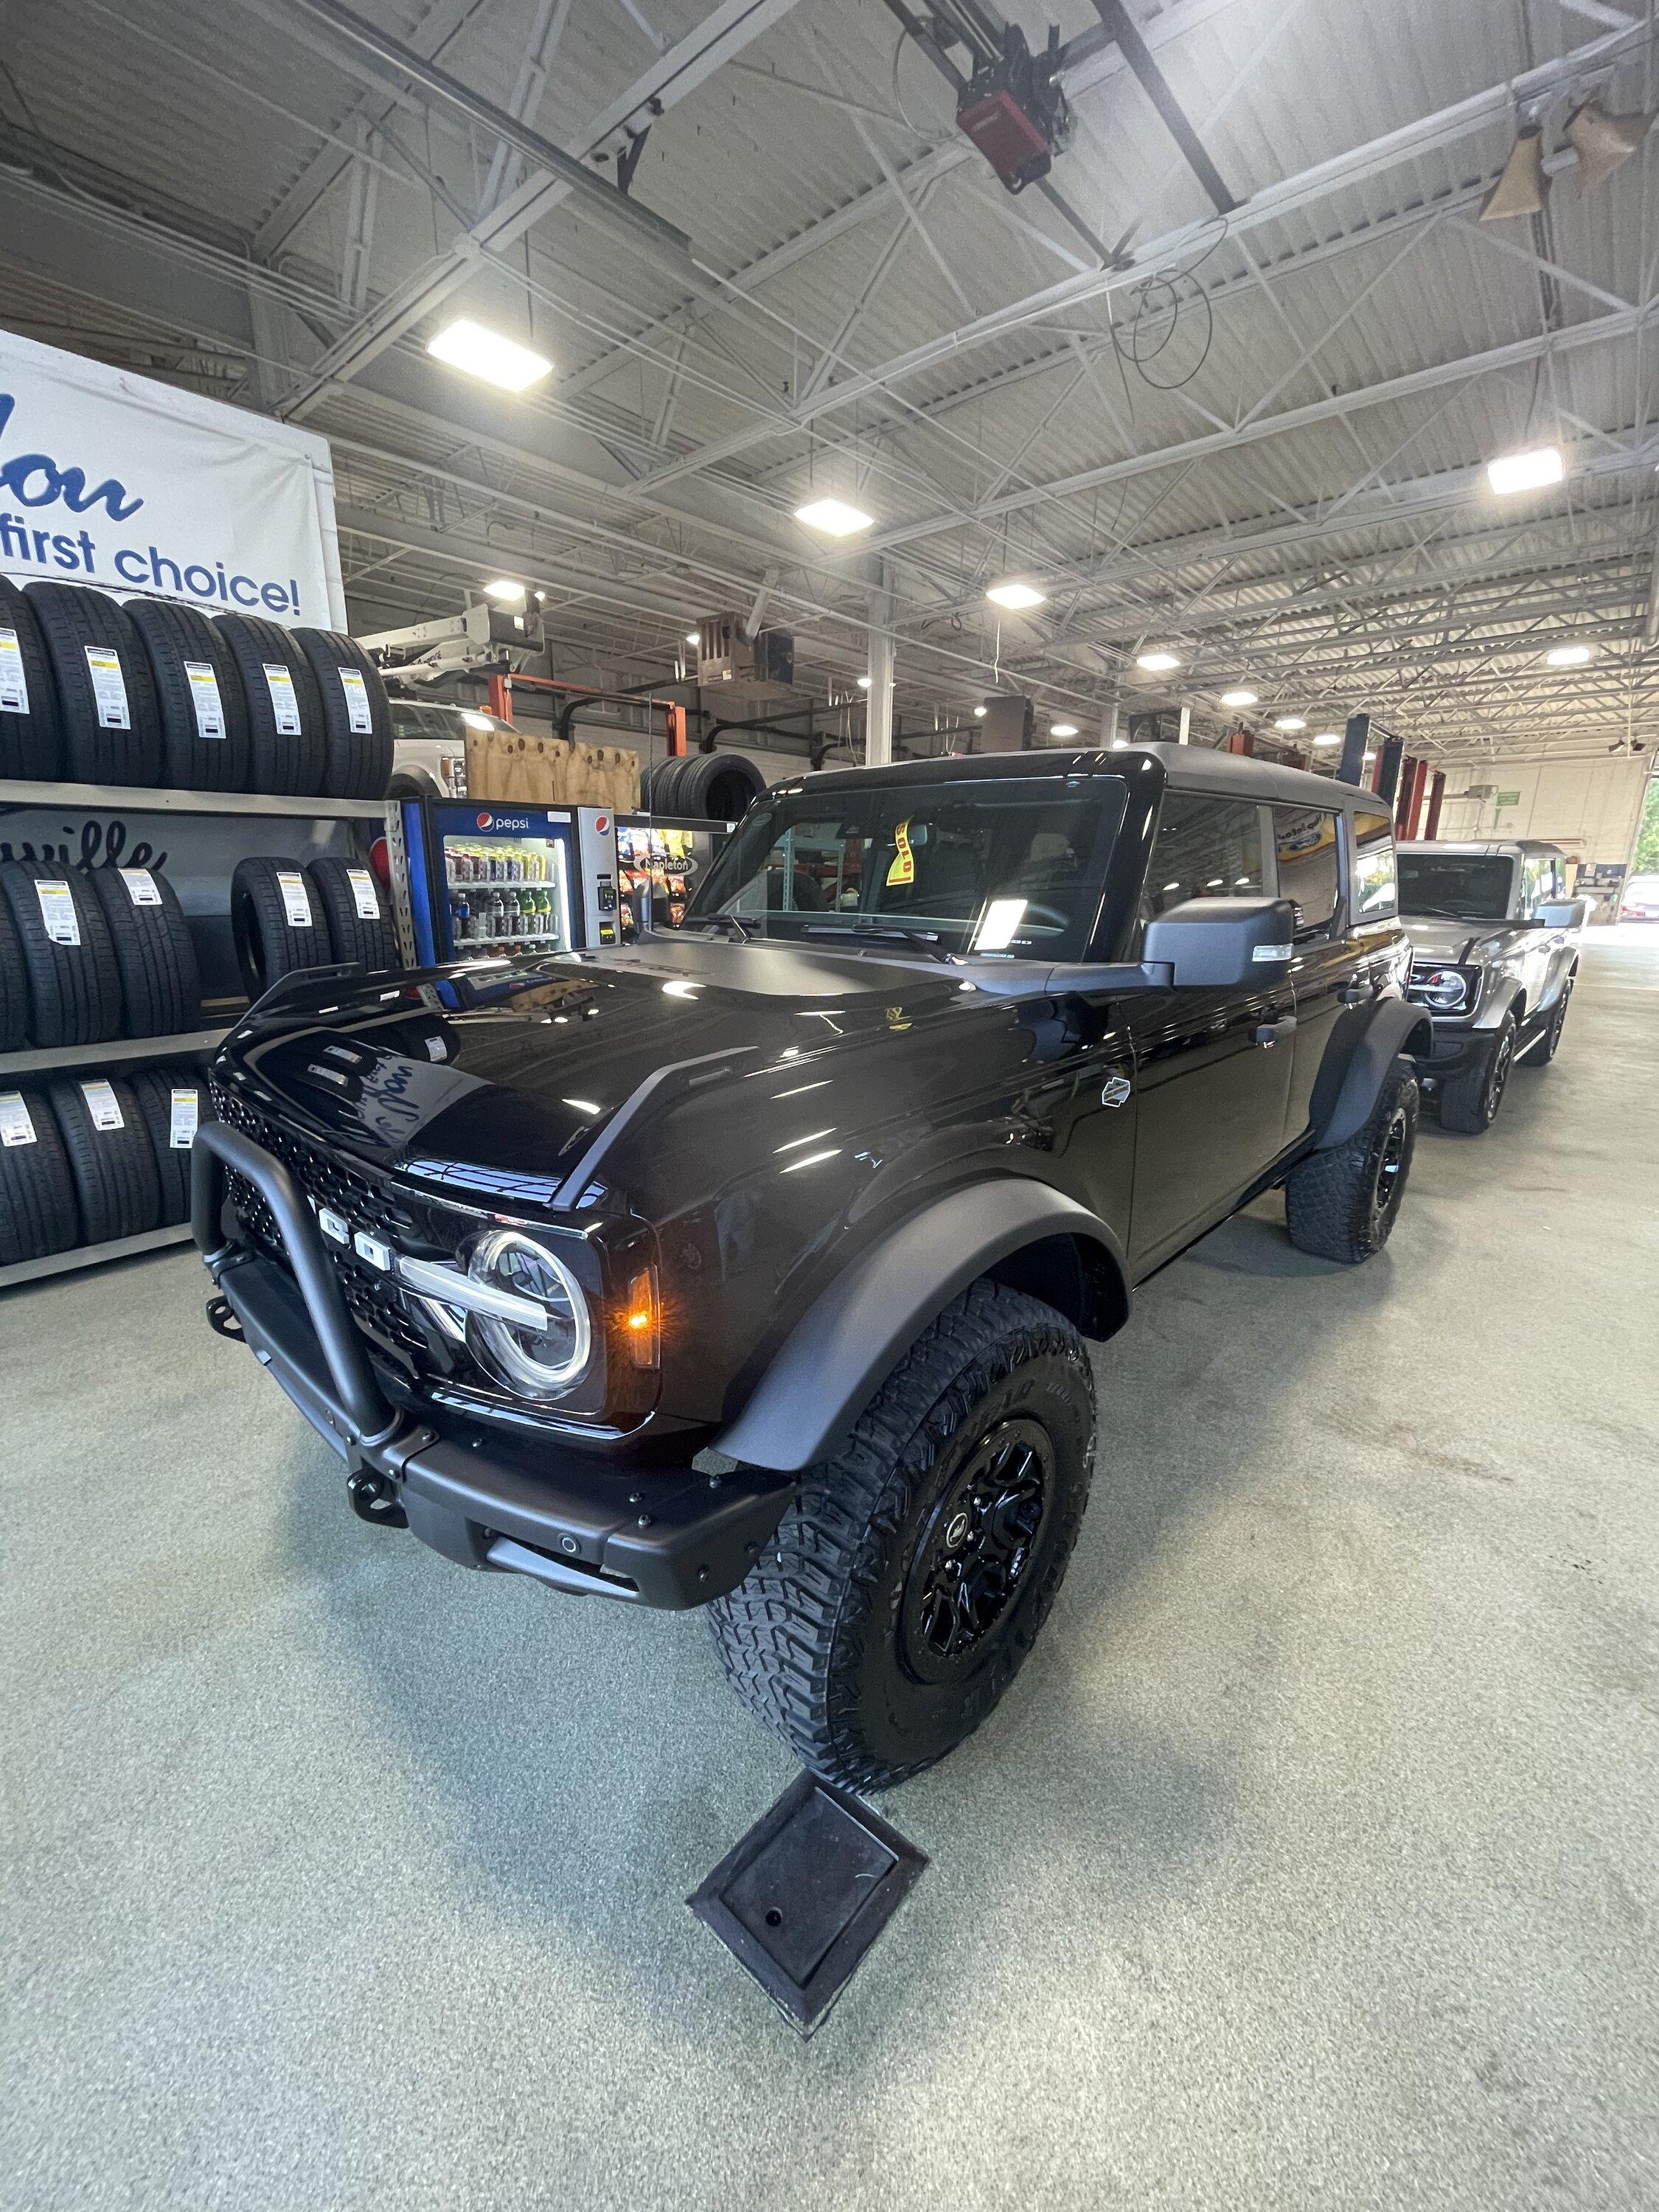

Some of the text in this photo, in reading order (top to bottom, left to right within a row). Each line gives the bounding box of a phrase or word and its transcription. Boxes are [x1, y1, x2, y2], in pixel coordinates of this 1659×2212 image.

[0, 393, 144, 521] ou
[0, 512, 301, 616] first choice!
[495, 817, 529, 830] pepsi
[895, 824, 912, 873] SOLD
